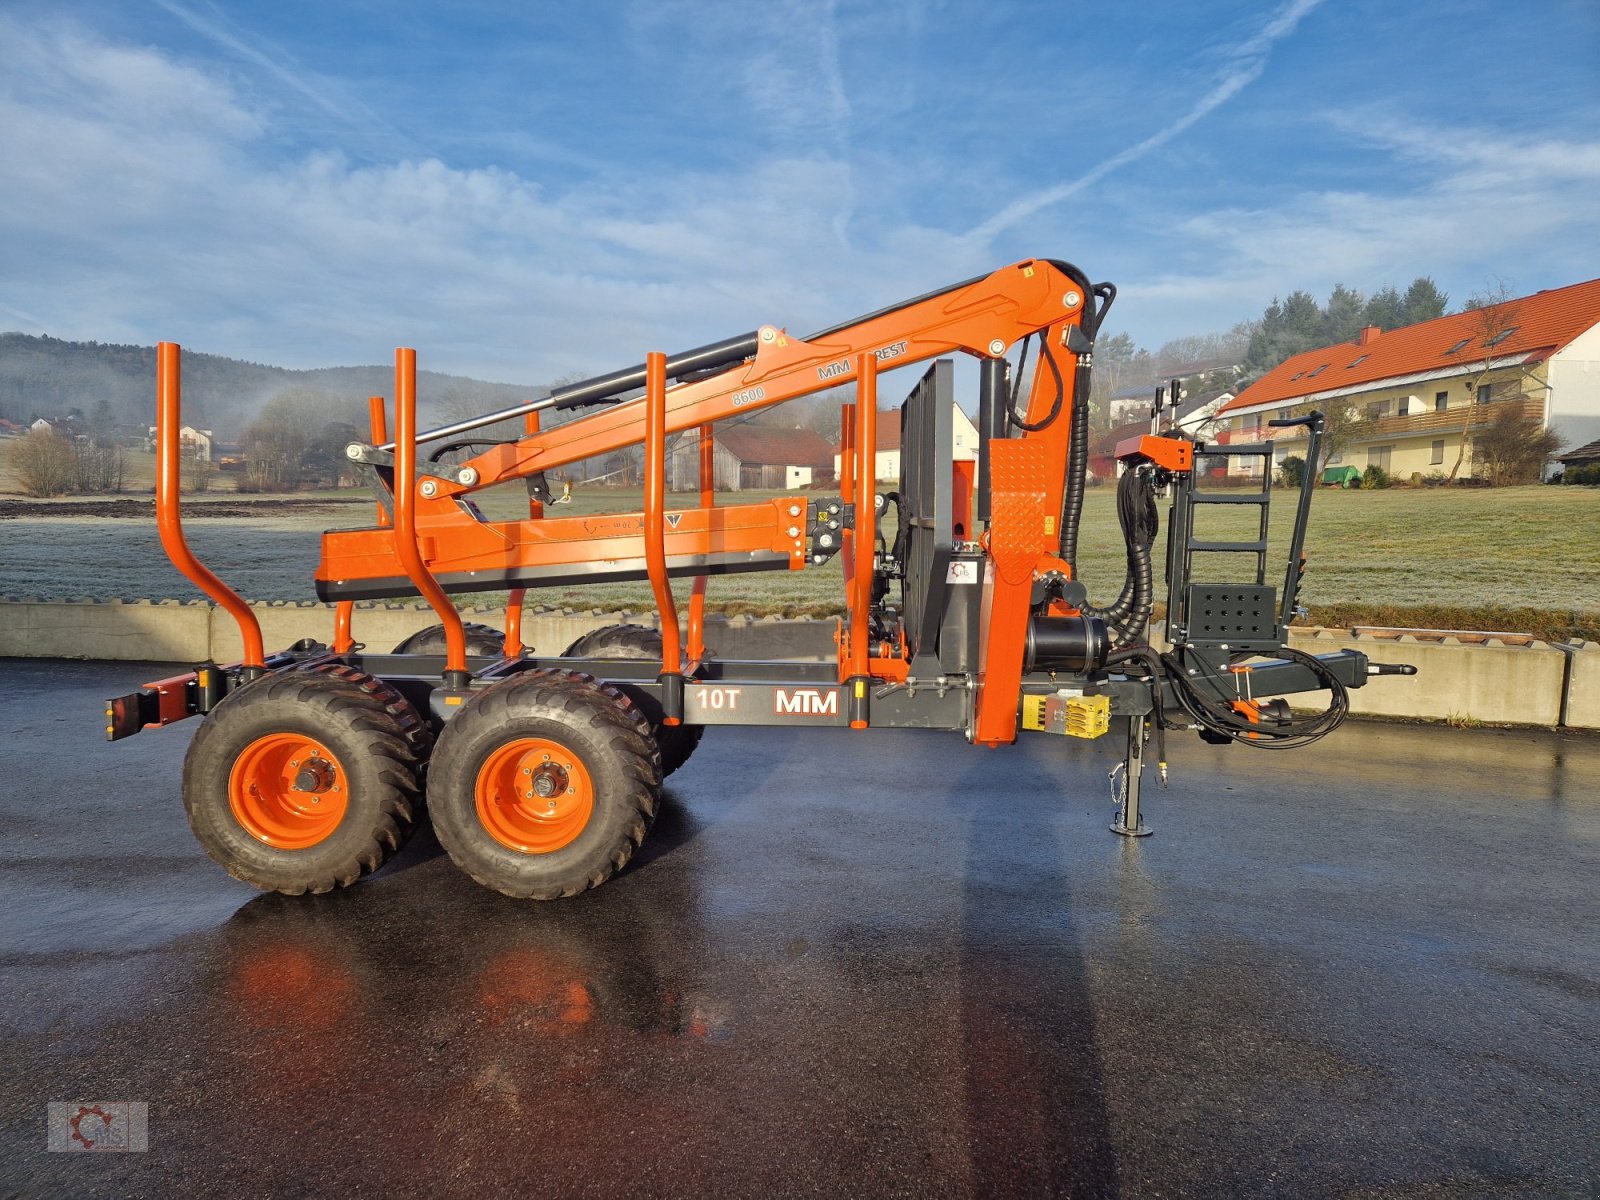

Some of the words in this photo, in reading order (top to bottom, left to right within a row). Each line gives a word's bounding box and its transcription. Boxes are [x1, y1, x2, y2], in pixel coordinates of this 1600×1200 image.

[817, 358, 850, 380] MTM
[856, 341, 907, 362] REST
[732, 387, 764, 405] 8600
[697, 689, 740, 709] 10T
[775, 689, 838, 714] MTM
